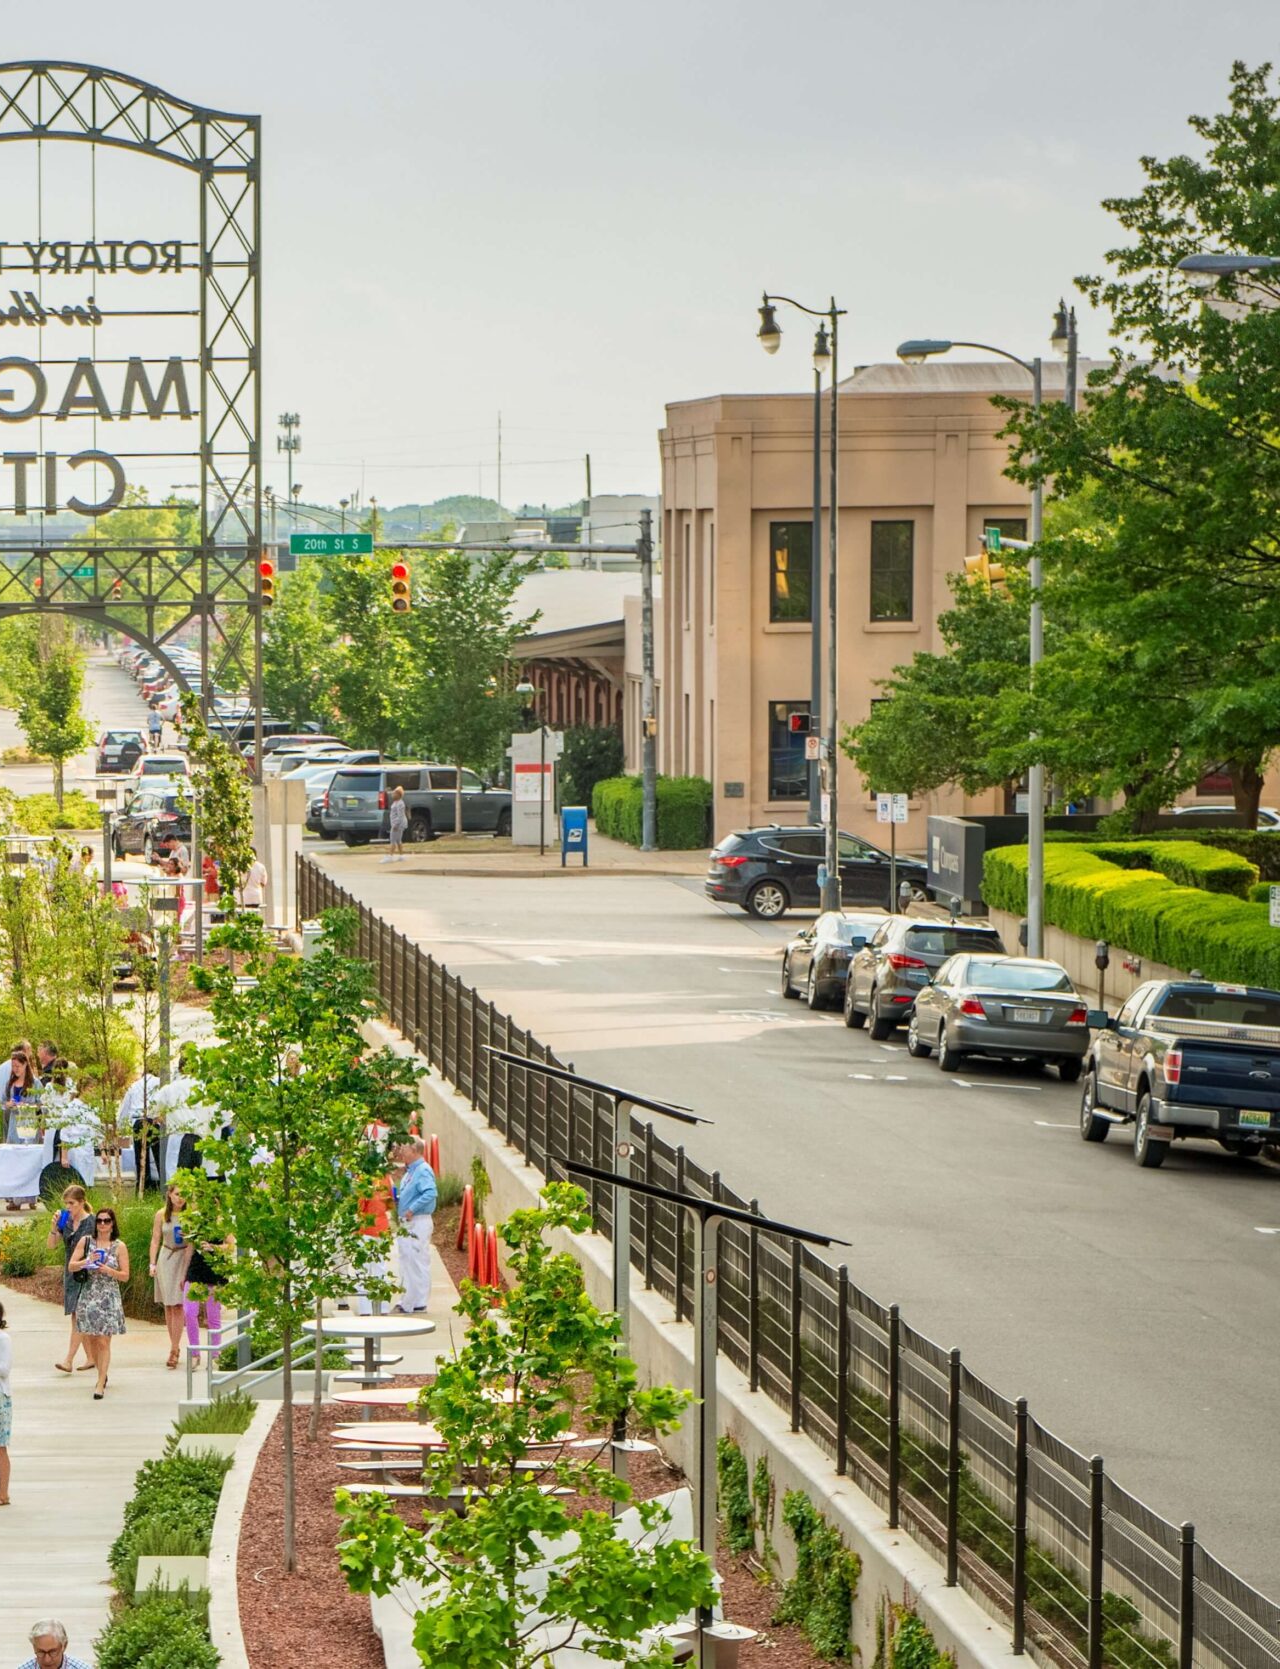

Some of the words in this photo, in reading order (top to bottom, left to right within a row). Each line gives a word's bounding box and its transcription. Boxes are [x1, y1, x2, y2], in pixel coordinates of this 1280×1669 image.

[304, 538, 327, 550] 20th
[334, 538, 345, 550] St
[352, 538, 359, 550] S
